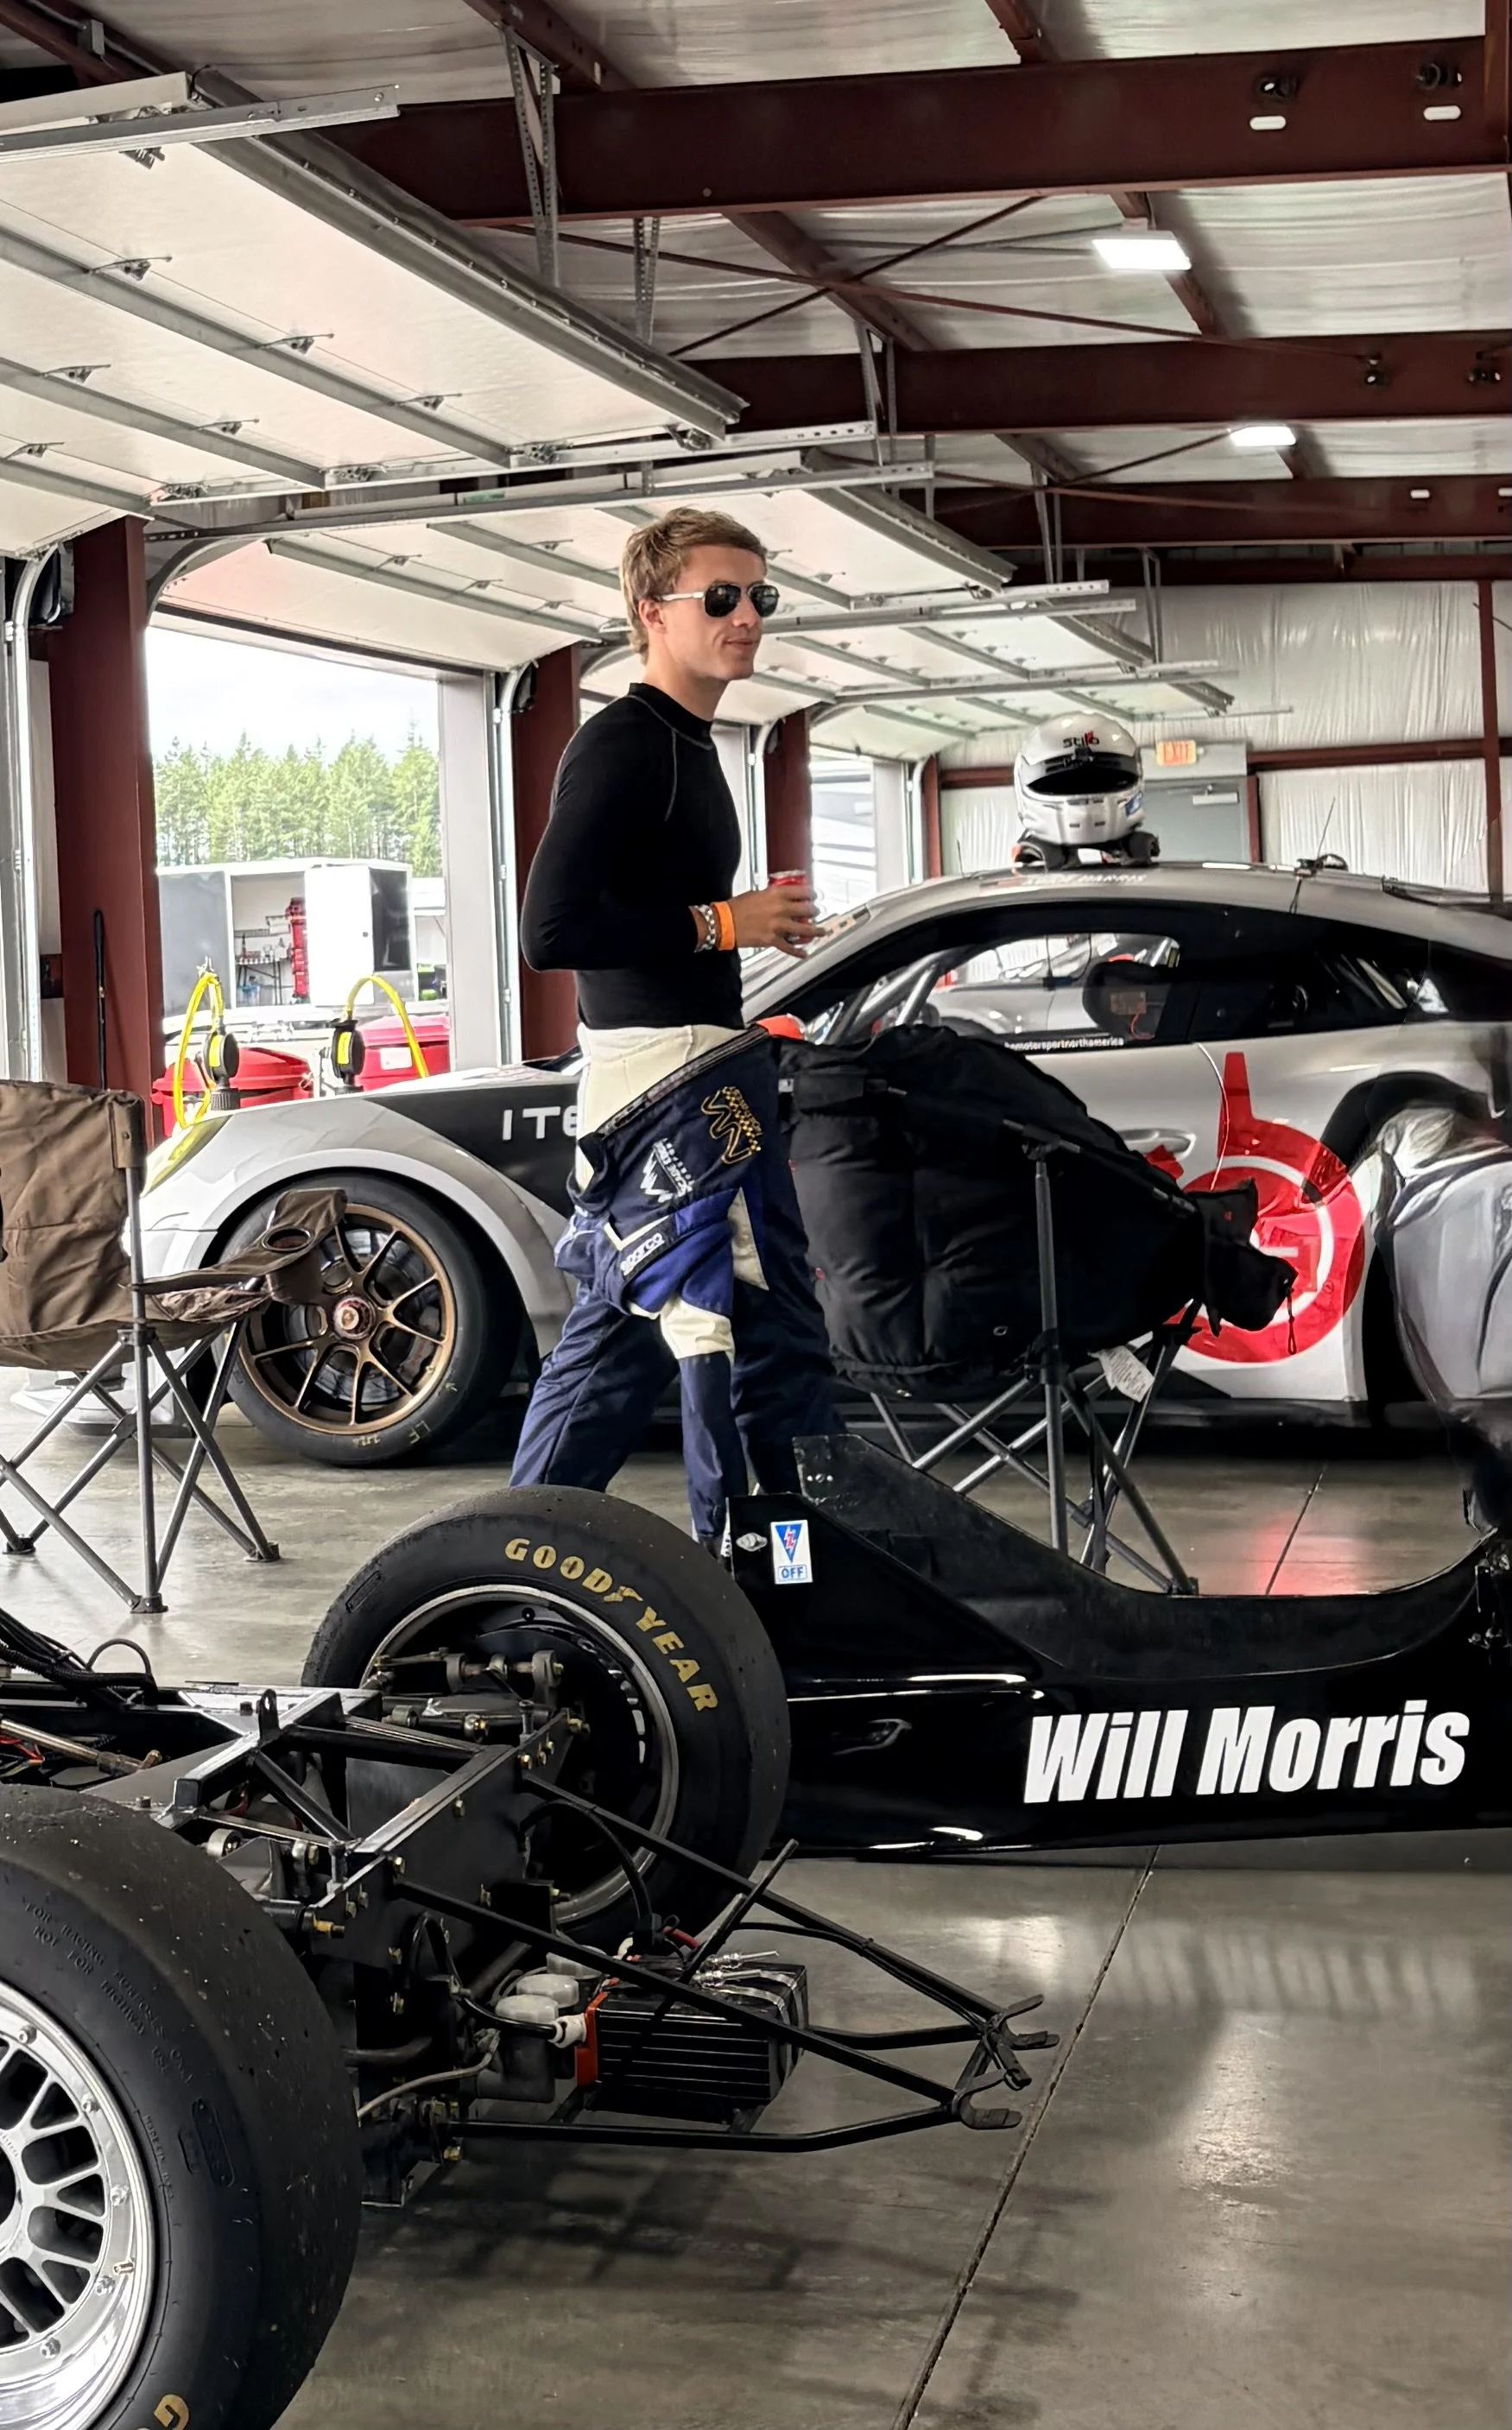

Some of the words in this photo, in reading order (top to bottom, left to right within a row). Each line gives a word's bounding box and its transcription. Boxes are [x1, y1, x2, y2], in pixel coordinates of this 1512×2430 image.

[1162, 742, 1190, 764] EXIT
[781, 1566, 804, 1579] OFF
[504, 1537, 719, 1712] GOODYEAR
[1023, 1708, 1189, 1803] Will
[1195, 1699, 1470, 1794] Morris
